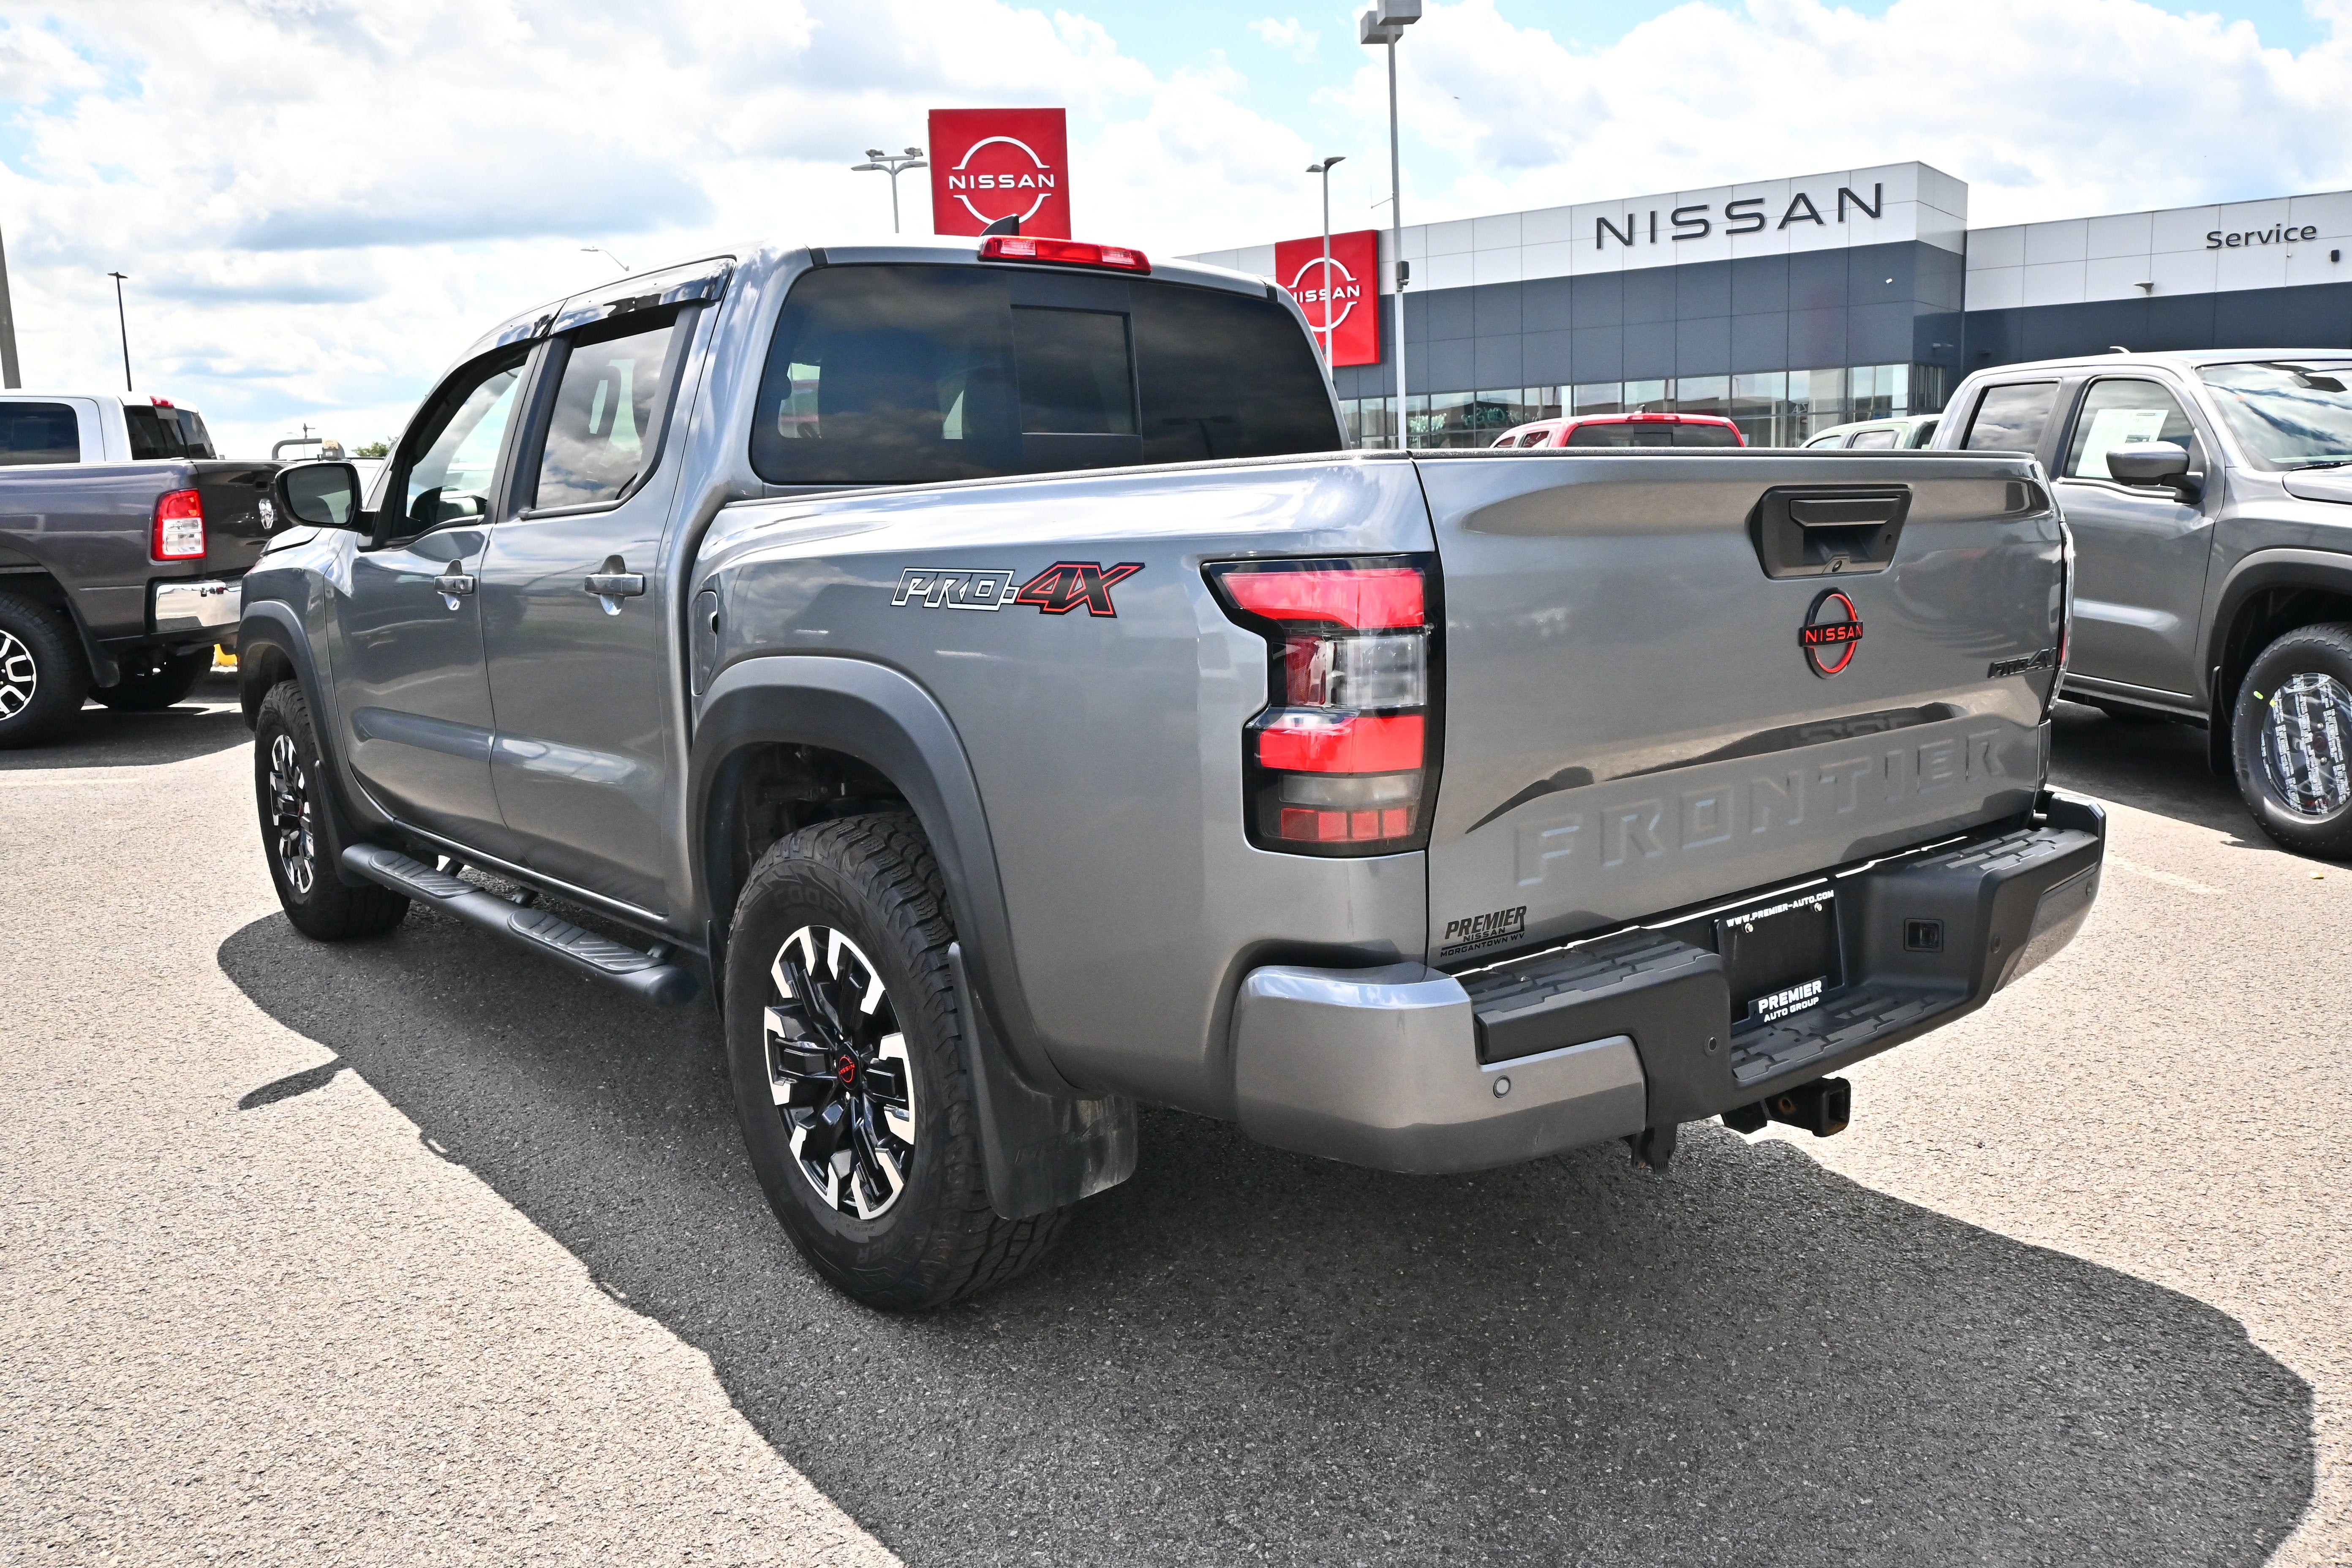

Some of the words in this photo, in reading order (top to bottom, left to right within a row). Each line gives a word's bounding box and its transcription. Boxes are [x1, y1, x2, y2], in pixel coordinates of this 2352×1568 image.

[949, 174, 1055, 189] NISSAN
[1596, 182, 1883, 250] NISSAN
[2206, 223, 2317, 249] Service
[1805, 625, 1862, 642] NISSAN
[1514, 727, 2007, 888] FRONTIER
[1726, 890, 1834, 928] WWW.PREMIER-AUTO.COM
[1444, 905, 1527, 940] PREMIER
[1463, 927, 1505, 942] NISSAN
[1440, 936, 1508, 958] MORGANTOWN
[1511, 933, 1525, 942] WV
[1758, 980, 1822, 1014] PREMIER
[1764, 1007, 1788, 1022] AUTO
[1790, 997, 1819, 1013] GROUP
